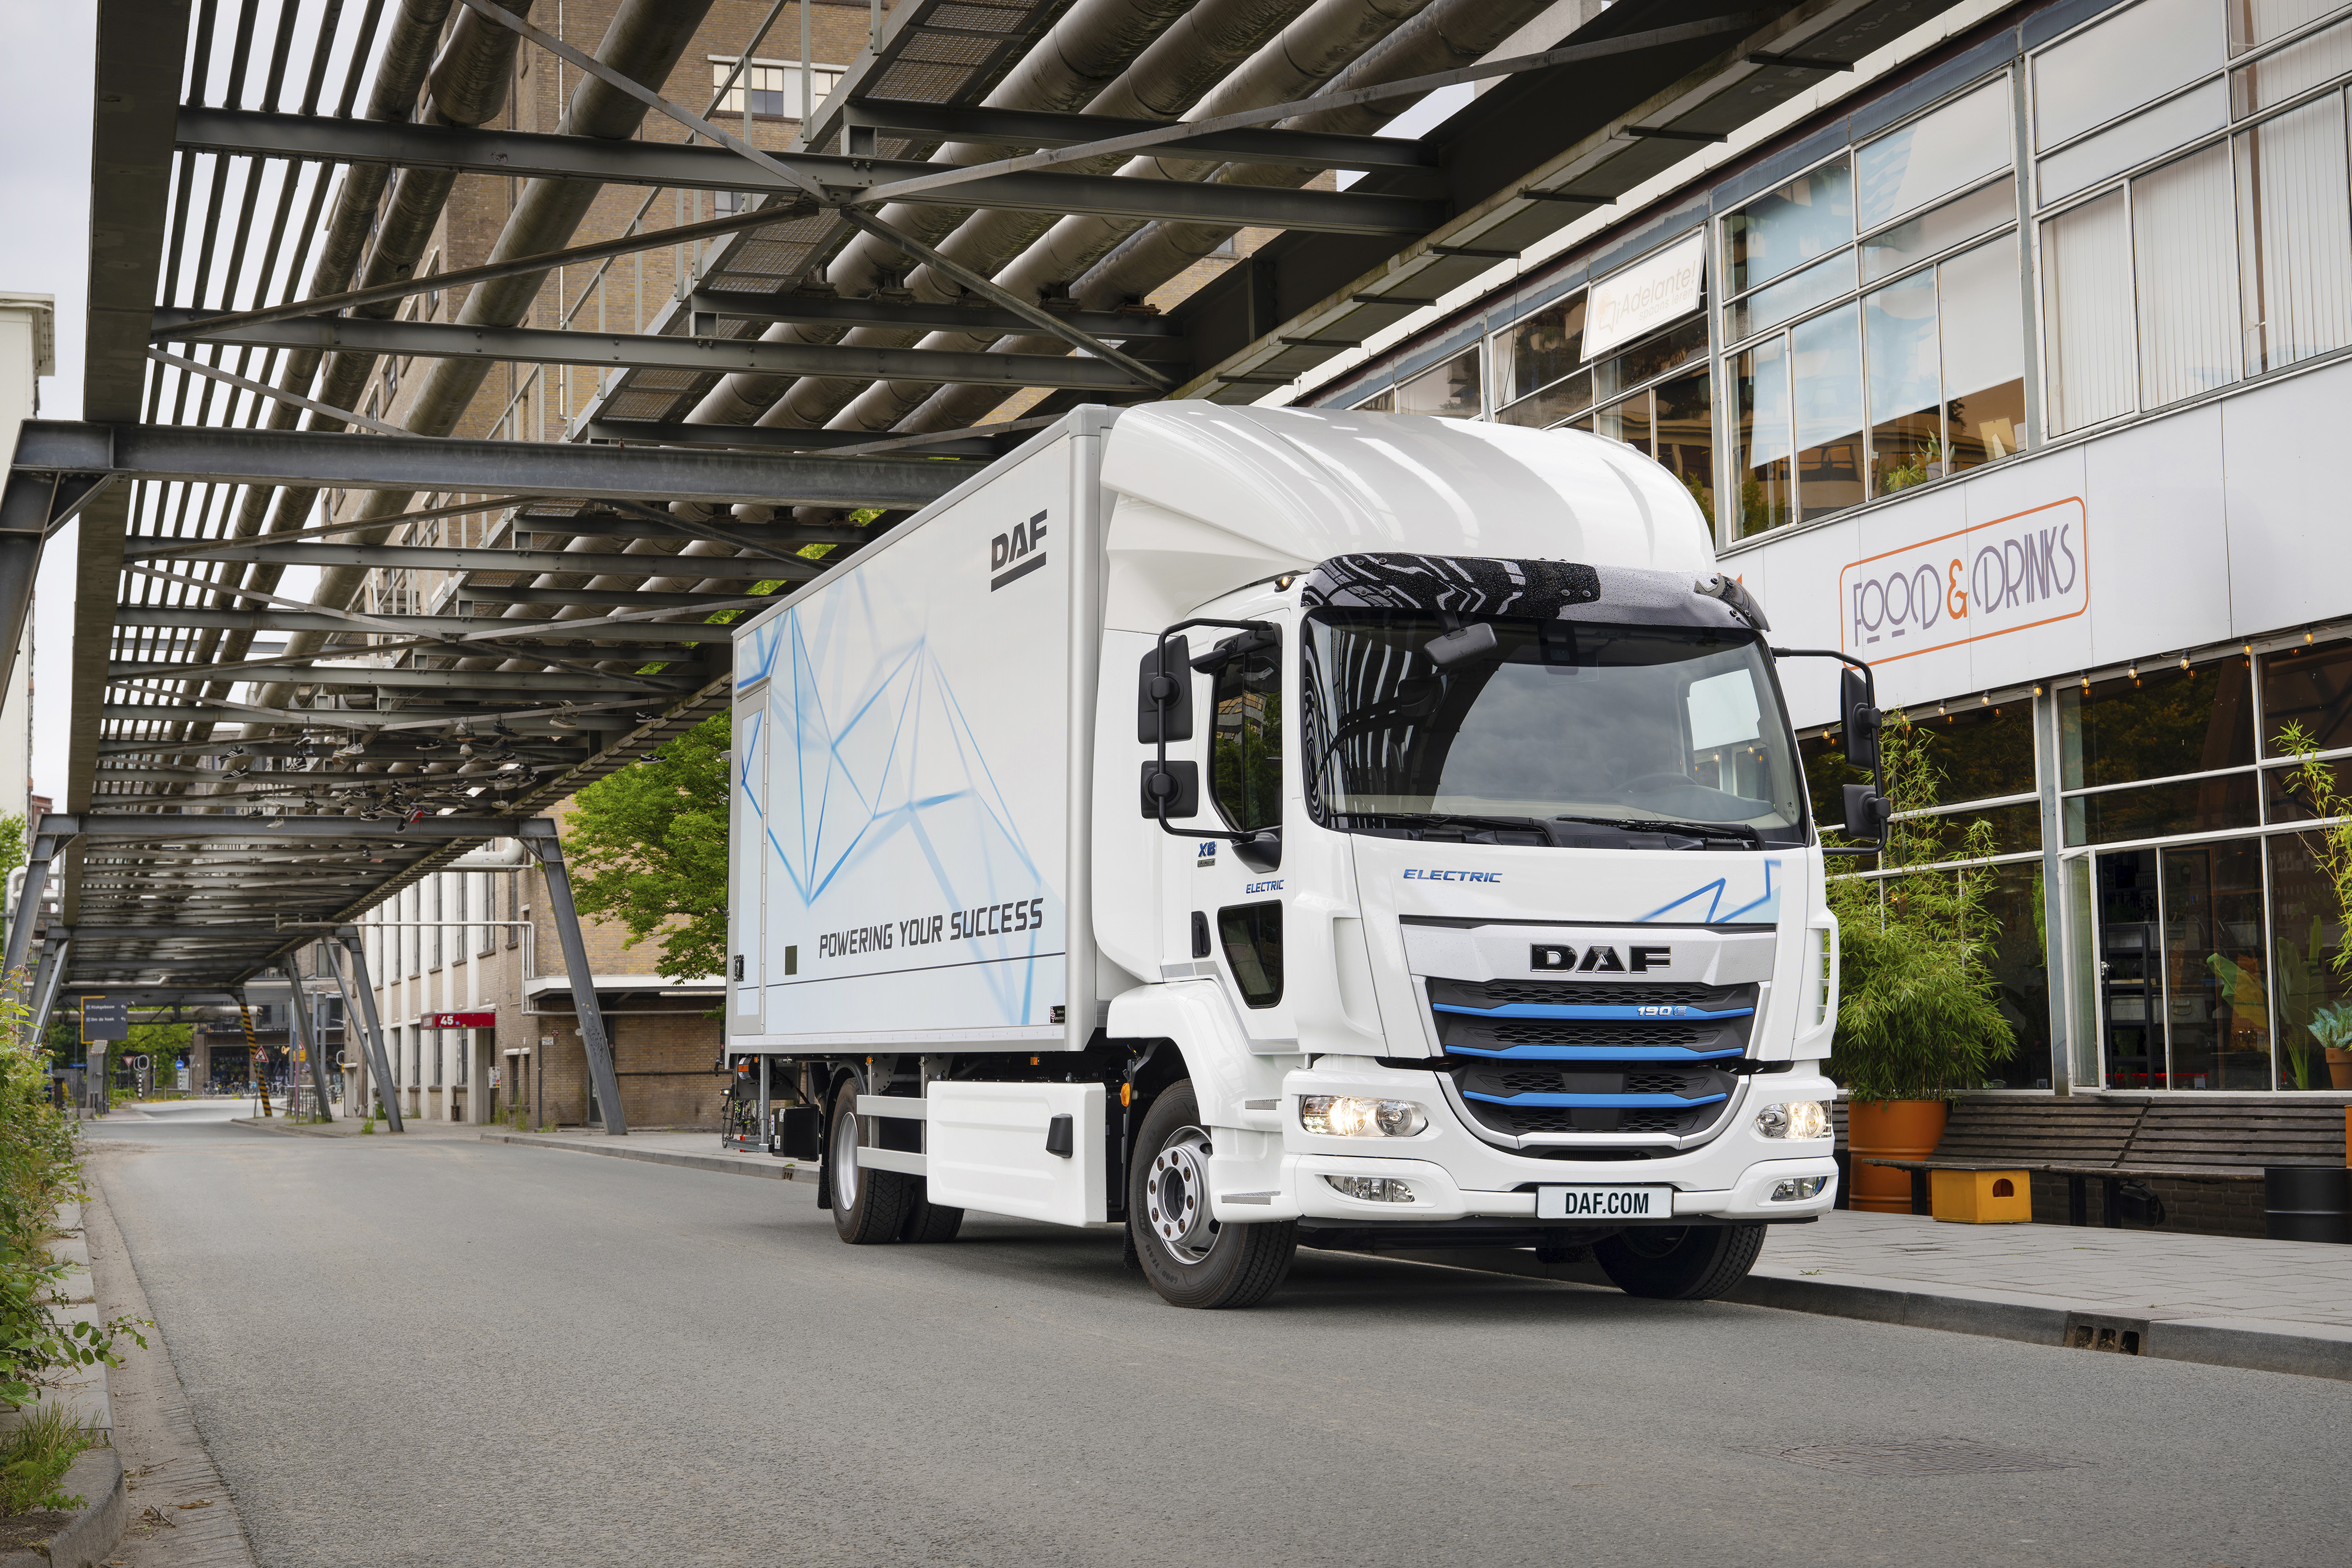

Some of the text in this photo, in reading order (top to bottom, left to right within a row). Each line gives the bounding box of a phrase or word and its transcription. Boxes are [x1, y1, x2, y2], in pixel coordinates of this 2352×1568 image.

[1639, 287, 1693, 323] spaans leren
[991, 509, 1047, 573] DAF
[1853, 523, 2076, 647] FOOD & DRINKS
[1198, 841, 1217, 857] XB
[1246, 880, 1284, 894] ELECTRIC
[1404, 869, 1502, 883] ELECTRIC
[819, 898, 1044, 959] POWERING YOUR SUCCESS
[1530, 943, 1671, 974] DAF
[440, 1016, 453, 1025] 45
[1565, 1192, 1649, 1215] DAF.COM
